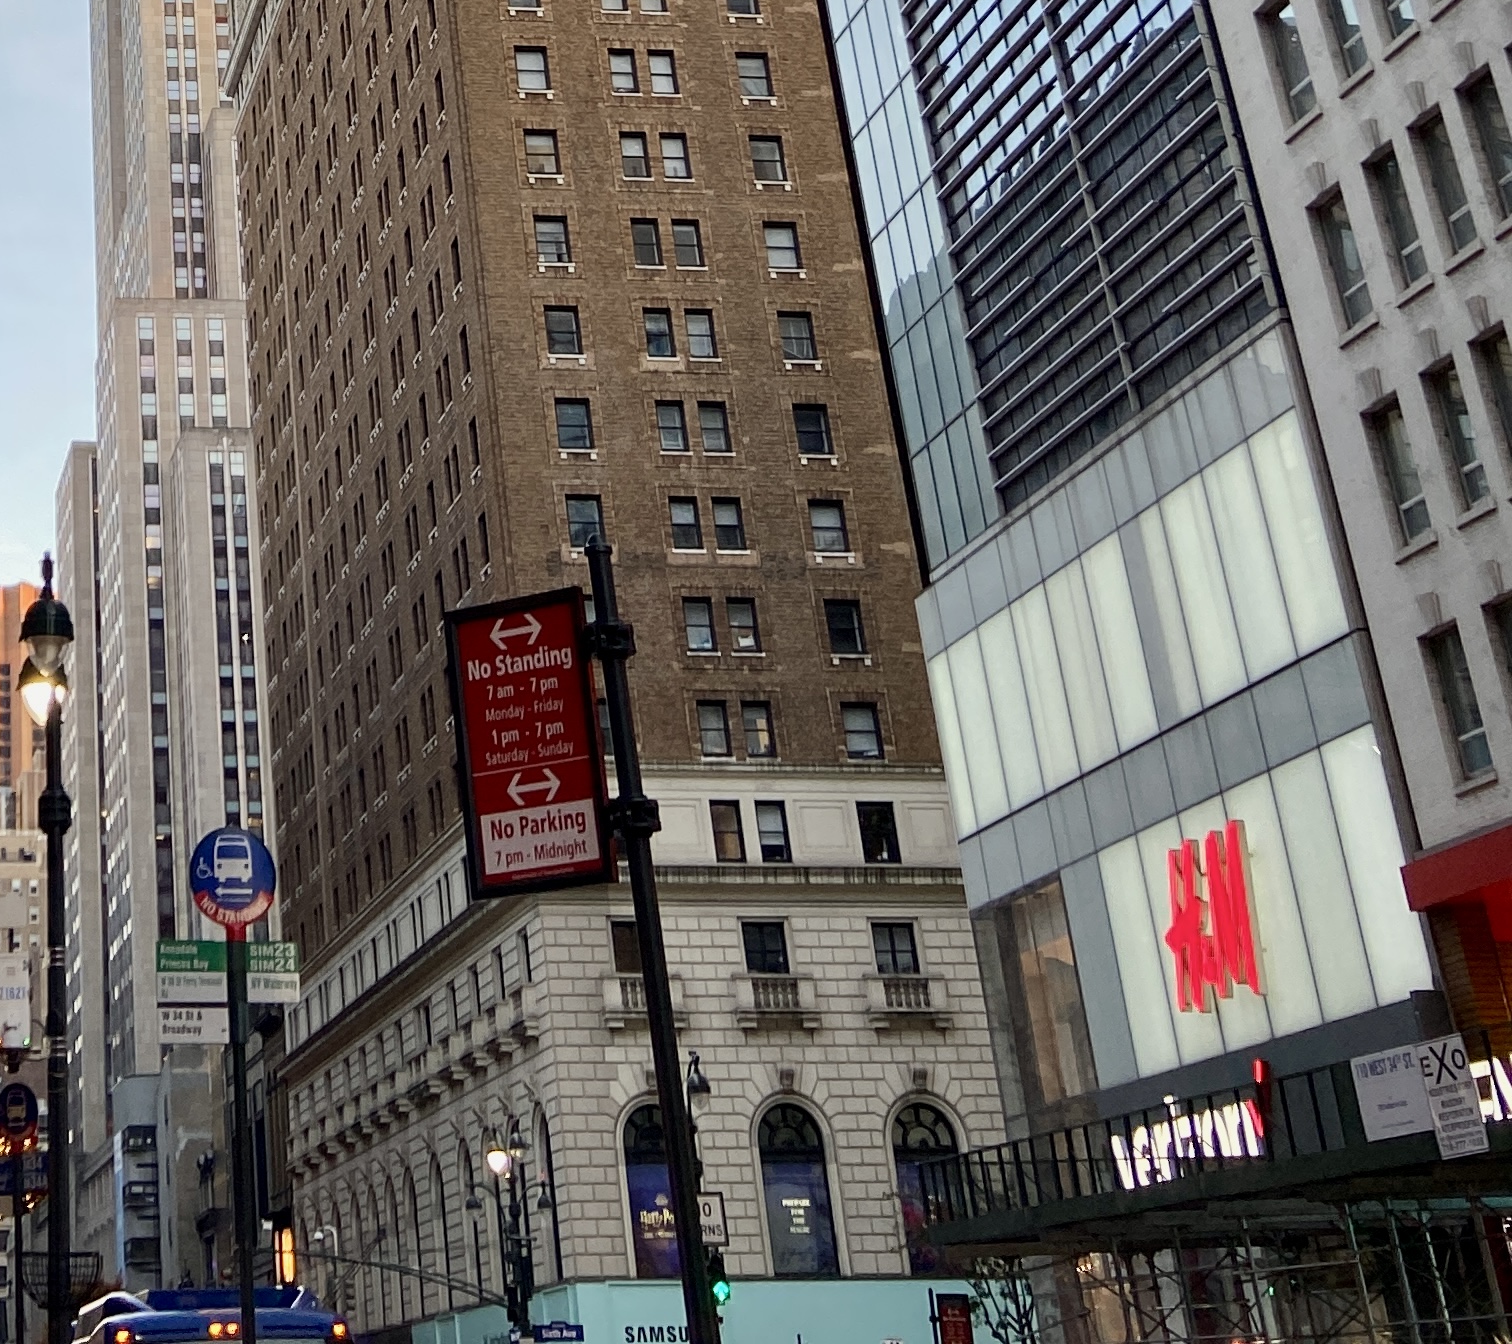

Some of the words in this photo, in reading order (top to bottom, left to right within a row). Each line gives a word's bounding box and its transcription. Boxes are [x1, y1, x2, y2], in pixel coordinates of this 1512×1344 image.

[467, 660, 491, 681] No
[495, 646, 572, 676] Standing
[487, 685, 493, 700] 7
[497, 685, 514, 699] am
[530, 677, 536, 692] 7
[540, 677, 558, 695] pm
[486, 704, 524, 722] Monday
[534, 697, 563, 713] Friday
[492, 729, 498, 745] 1
[502, 729, 520, 747] pm
[535, 722, 542, 737] 7
[546, 721, 564, 739] pm
[486, 748, 529, 766] Saturday
[538, 740, 574, 757] Sunday
[490, 819, 514, 841] No
[519, 809, 586, 837] Parking
[495, 850, 502, 867] 7
[506, 851, 524, 868] pm
[534, 839, 587, 860] Midnight
[200, 895, 216, 915] NO
[1165, 820, 1261, 1013] H&M
[250, 943, 295, 957] SIM23
[250, 958, 295, 971] SIM24
[162, 1024, 202, 1036] Broadway
[1420, 1042, 1466, 1085] EXO
[701, 1224, 723, 1237] RNS
[625, 1325, 689, 1344] SAMSU
